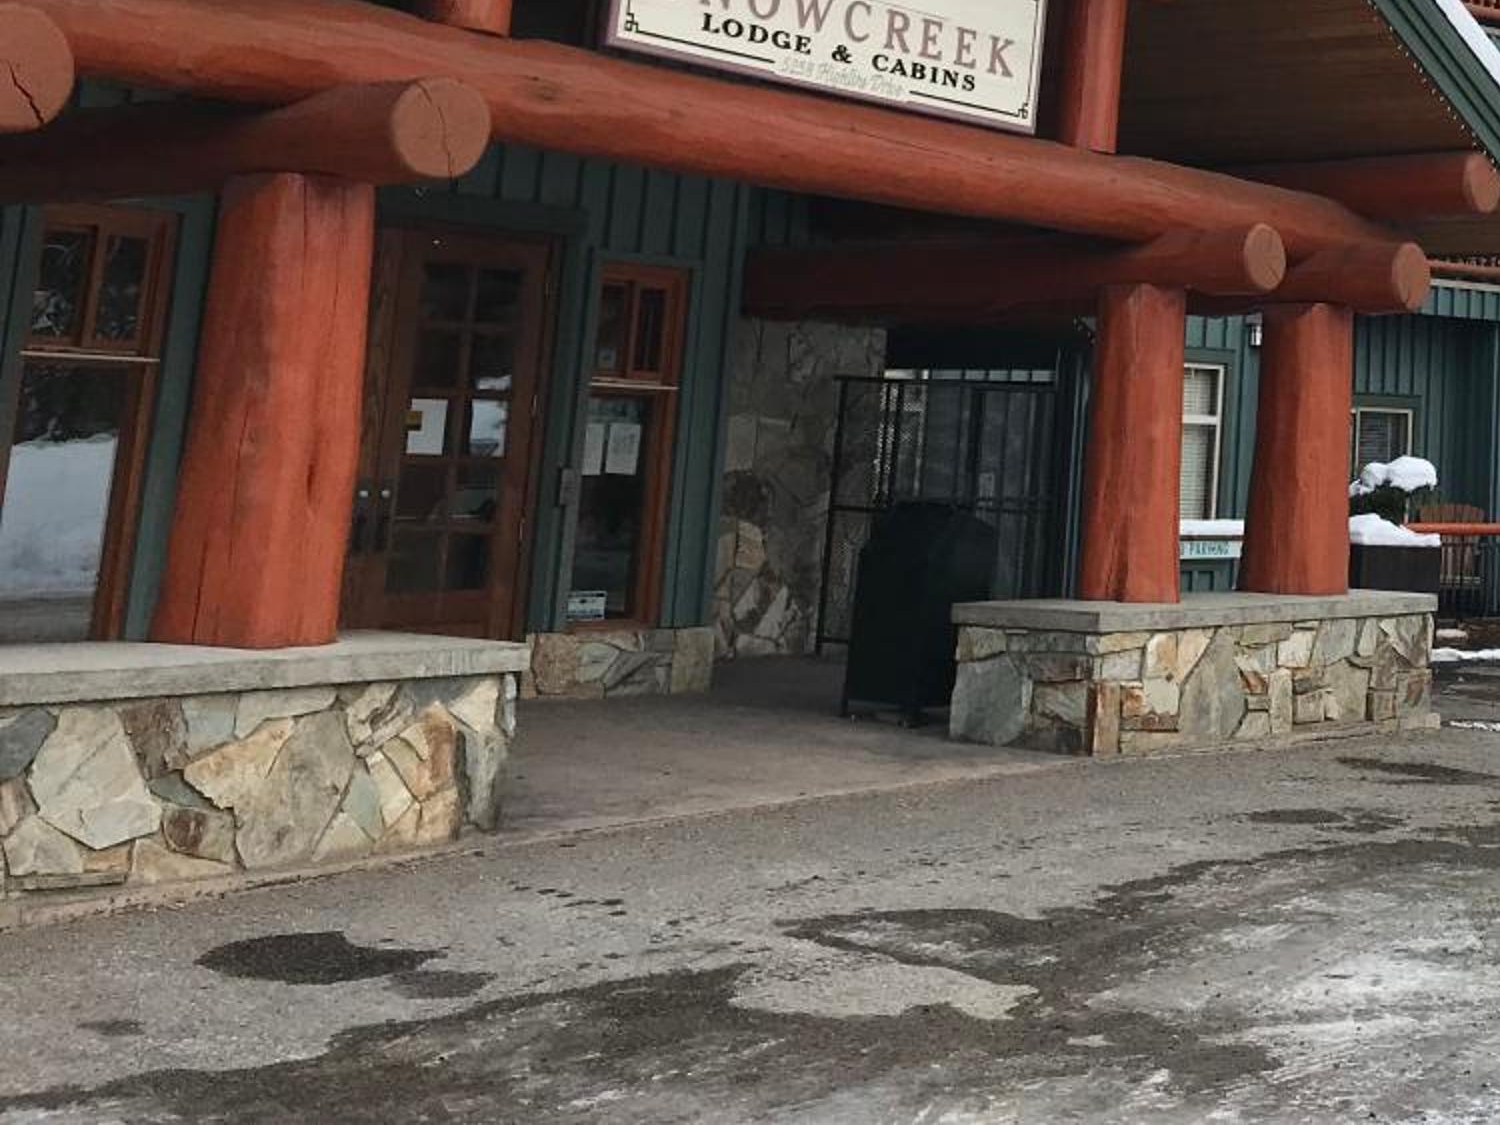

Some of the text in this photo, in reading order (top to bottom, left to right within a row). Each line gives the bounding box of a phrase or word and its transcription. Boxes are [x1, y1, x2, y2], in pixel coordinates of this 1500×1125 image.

[701, 12, 812, 55] LODGE
[831, 44, 853, 64] &
[871, 53, 976, 92] CABINS
